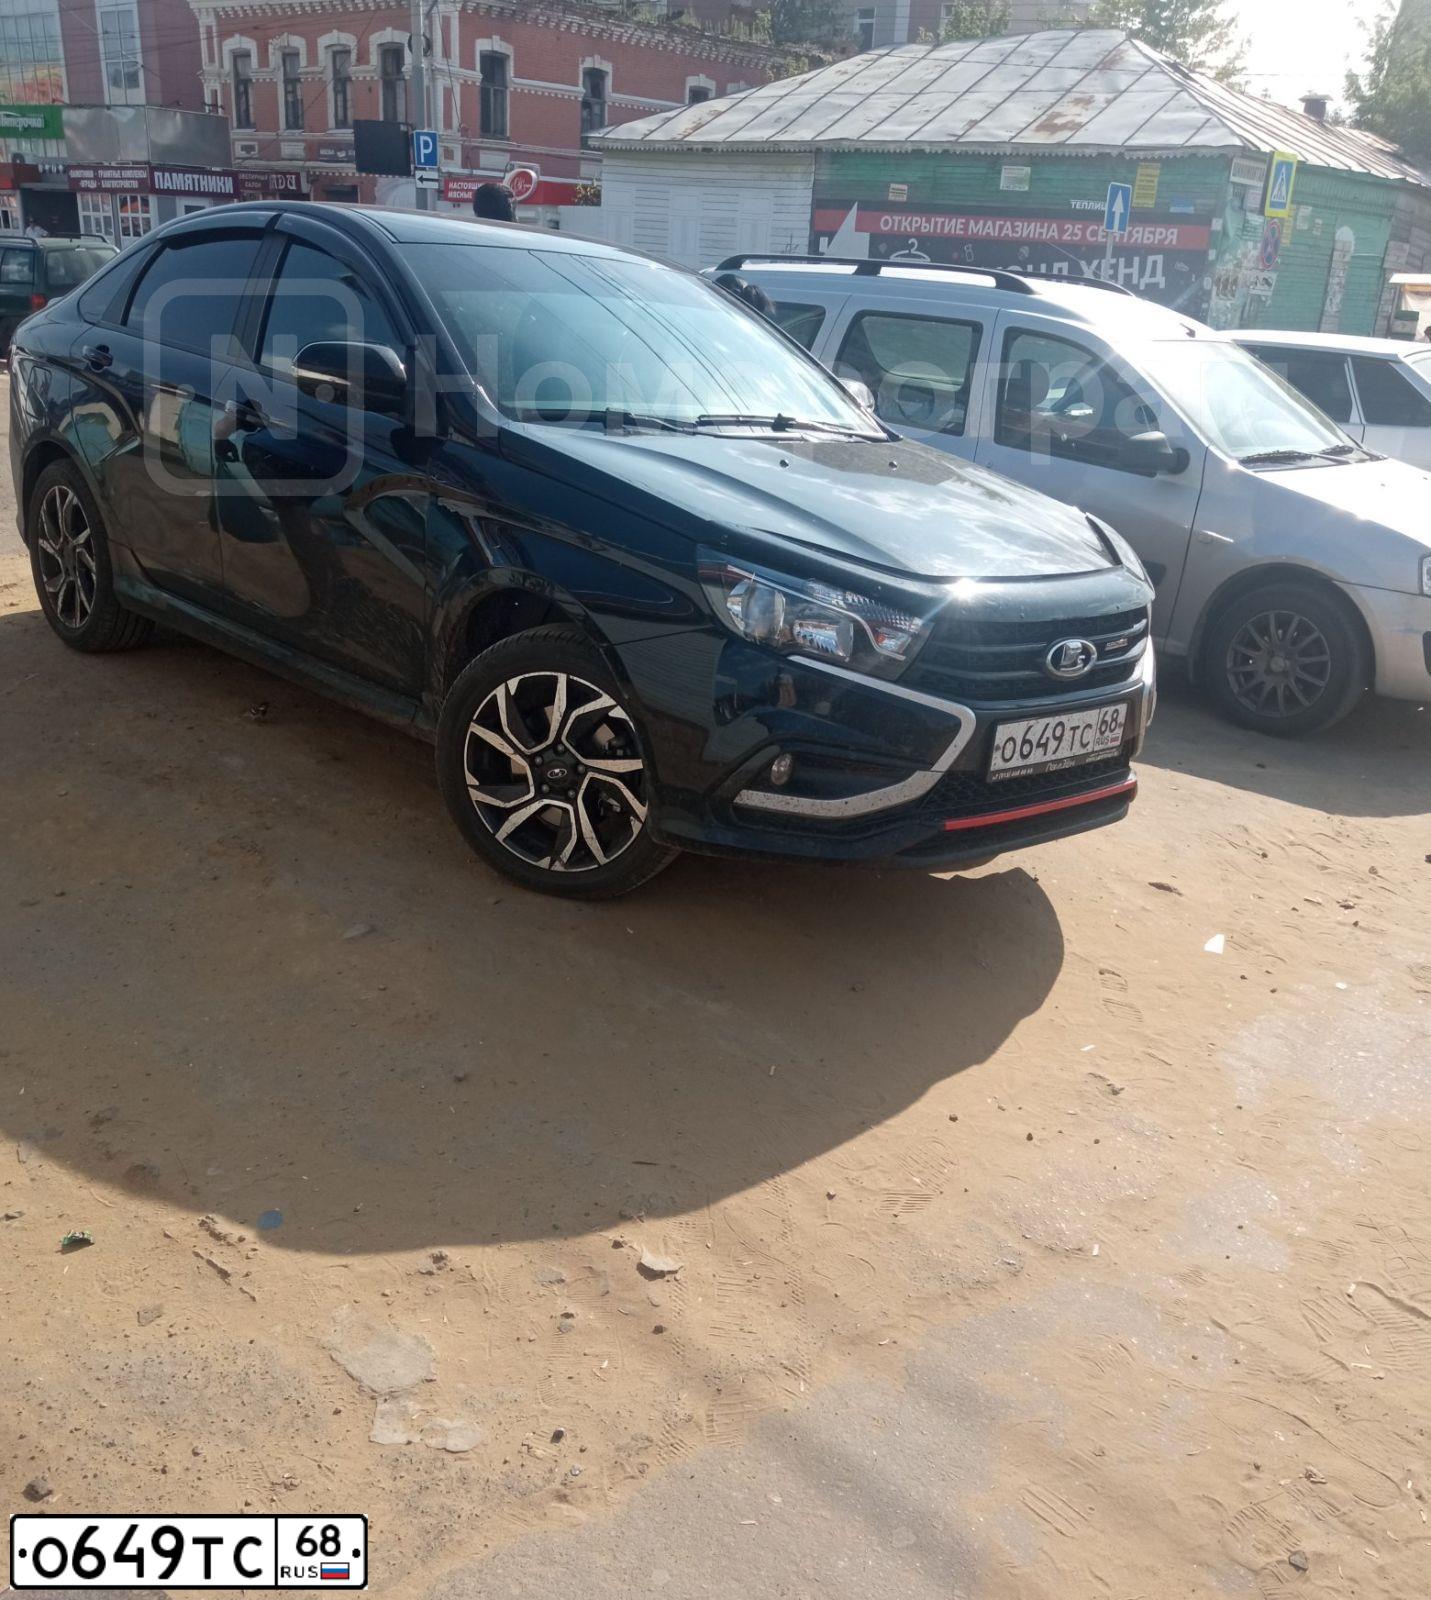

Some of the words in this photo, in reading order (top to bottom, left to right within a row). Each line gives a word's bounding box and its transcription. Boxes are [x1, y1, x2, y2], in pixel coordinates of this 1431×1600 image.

[419, 135, 433, 163] P
[154, 171, 234, 194] ПАМЯТНИКИ
[448, 181, 480, 191] НАСТОЯЩИ
[1070, 199, 1107, 211] ТЕПЛИЦ
[880, 214, 965, 234] ОТКРЫТИЕ
[967, 220, 1059, 240] МАГАЗИНА
[1064, 223, 1083, 240] 25
[1099, 708, 1119, 735] 68
